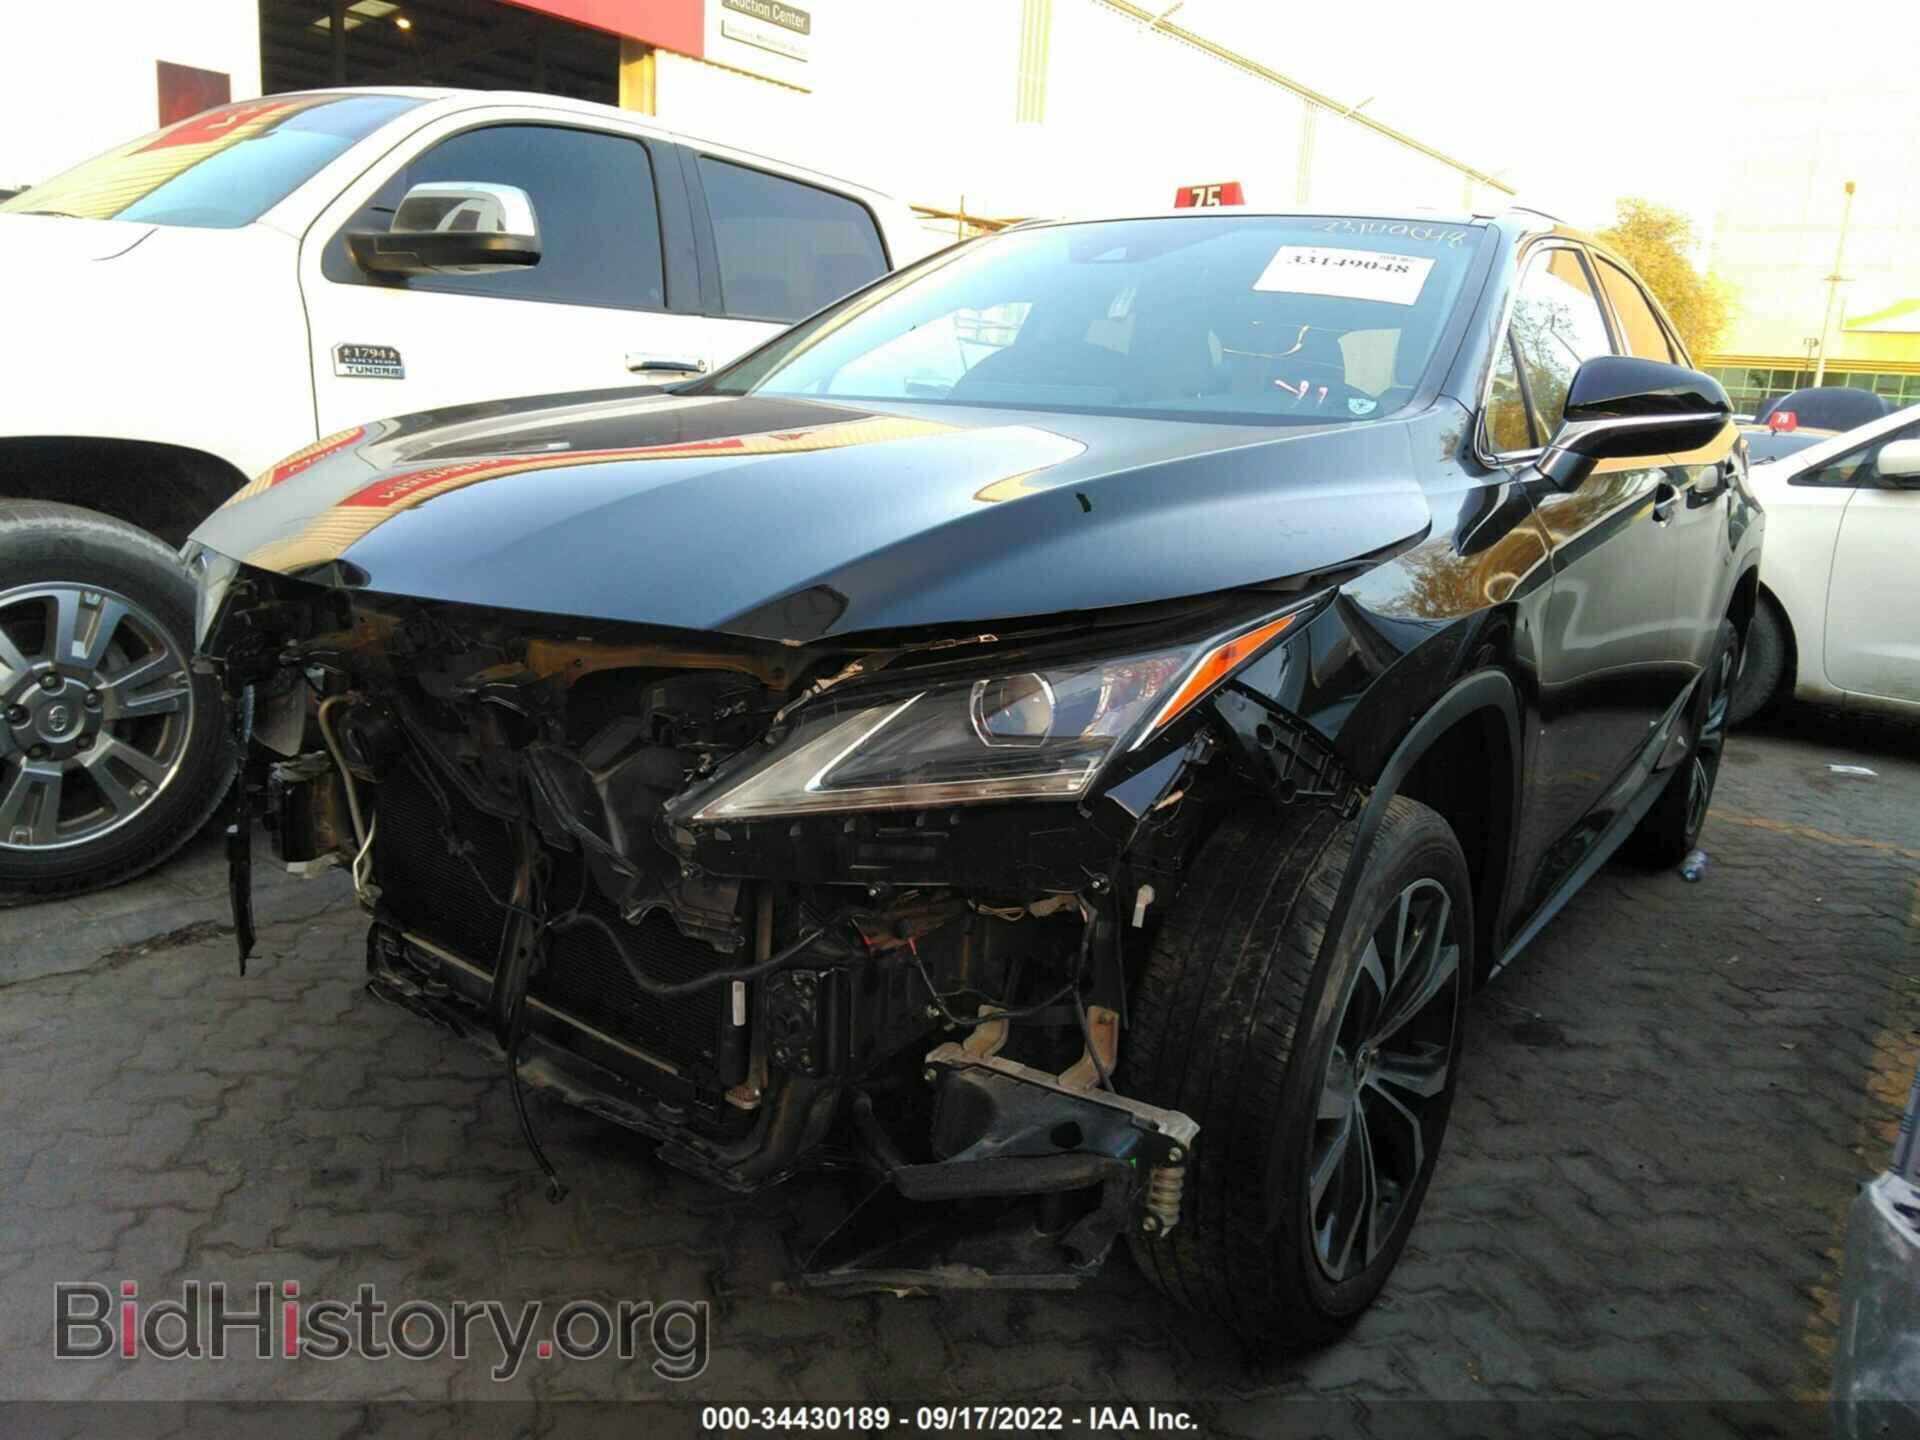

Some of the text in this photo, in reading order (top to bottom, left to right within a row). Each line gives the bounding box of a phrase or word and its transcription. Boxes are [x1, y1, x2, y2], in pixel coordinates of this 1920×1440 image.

[772, 4, 806, 28] Center
[1191, 185, 1221, 207] 75
[1286, 255, 1410, 273] 33149048
[353, 347, 386, 358] 1794
[346, 365, 401, 374] TUNDRA
